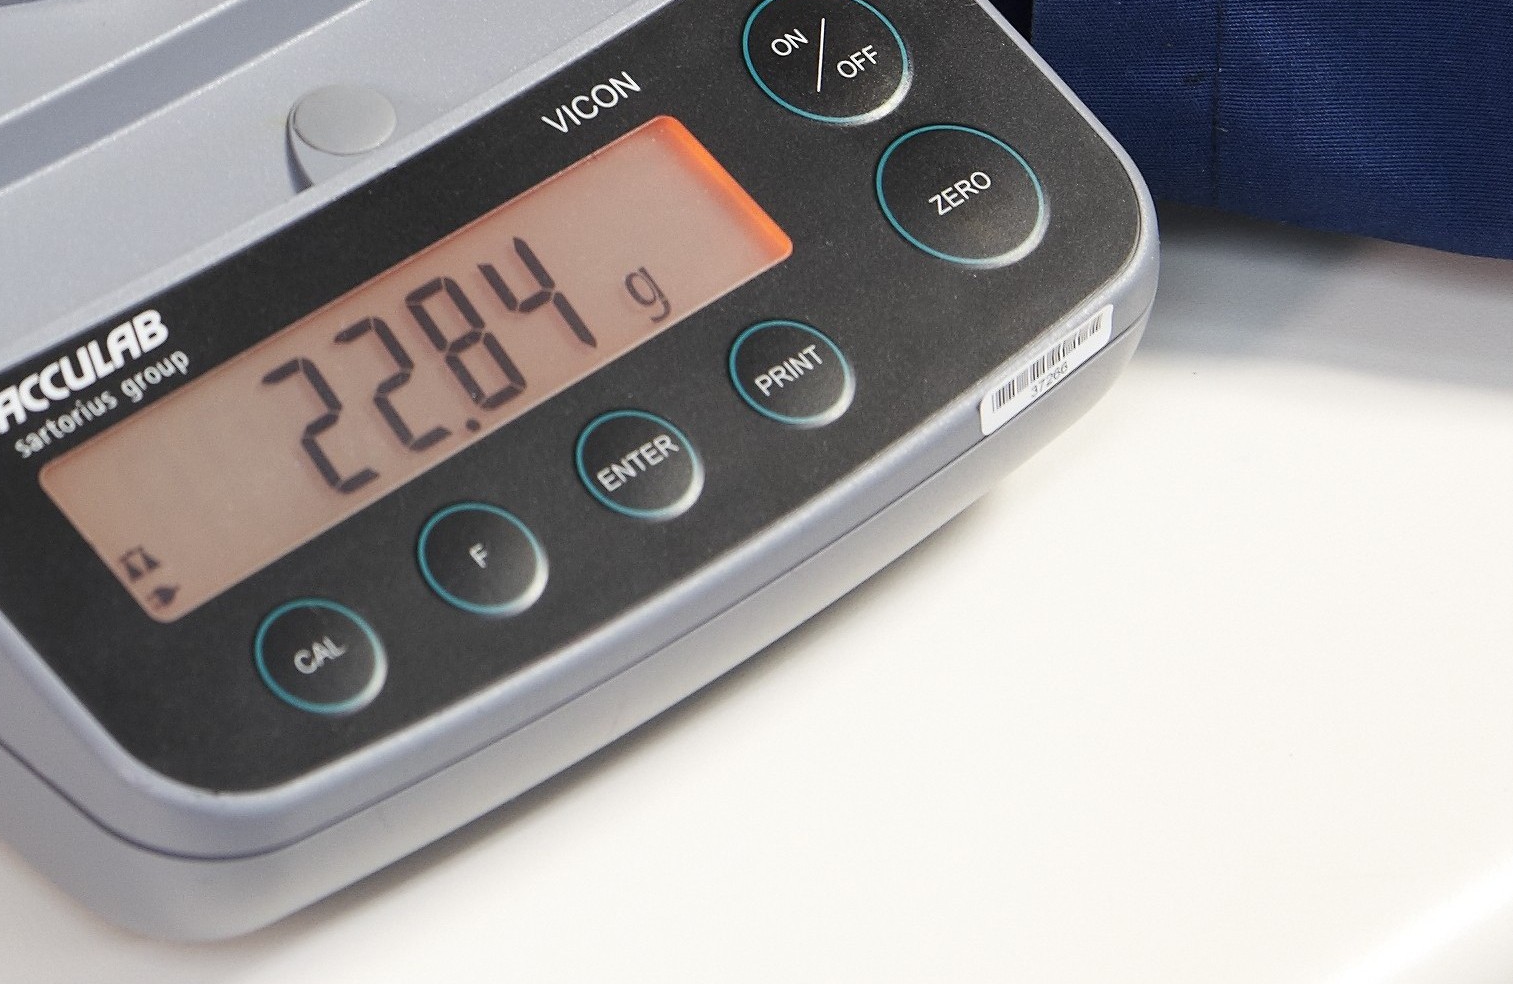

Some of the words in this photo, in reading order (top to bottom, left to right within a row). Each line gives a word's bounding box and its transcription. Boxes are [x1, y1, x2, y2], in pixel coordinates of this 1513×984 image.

[771, 28, 809, 57] ON
[836, 44, 878, 79] OFF
[541, 70, 642, 133] VICON
[928, 171, 992, 216] ZERO
[260, 226, 599, 496] 22.84
[623, 266, 672, 324] g
[754, 343, 824, 397] PRINT
[14, 389, 120, 459] sartorius
[120, 350, 190, 404] group
[596, 434, 681, 493] ENTER
[468, 542, 489, 569] F
[293, 634, 350, 676] CAL
